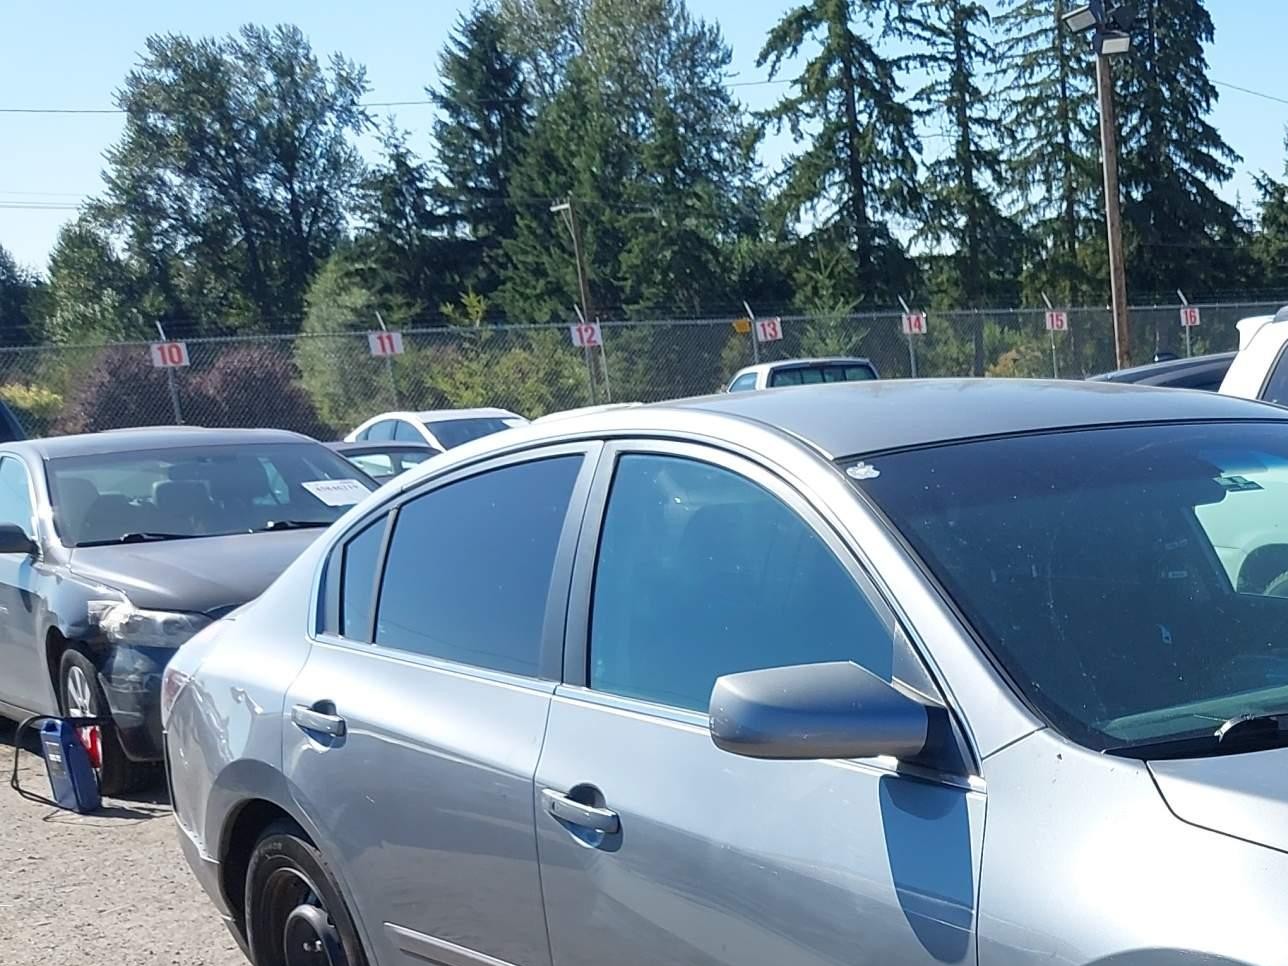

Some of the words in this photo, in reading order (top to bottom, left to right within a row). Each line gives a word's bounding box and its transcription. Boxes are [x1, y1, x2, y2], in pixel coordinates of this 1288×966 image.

[906, 315, 922, 332] 14
[1050, 312, 1064, 329] 15
[1183, 309, 1197, 325] 16
[576, 325, 597, 345] 12
[760, 321, 778, 339] 13
[376, 334, 396, 353] 11
[157, 343, 185, 365] 10
